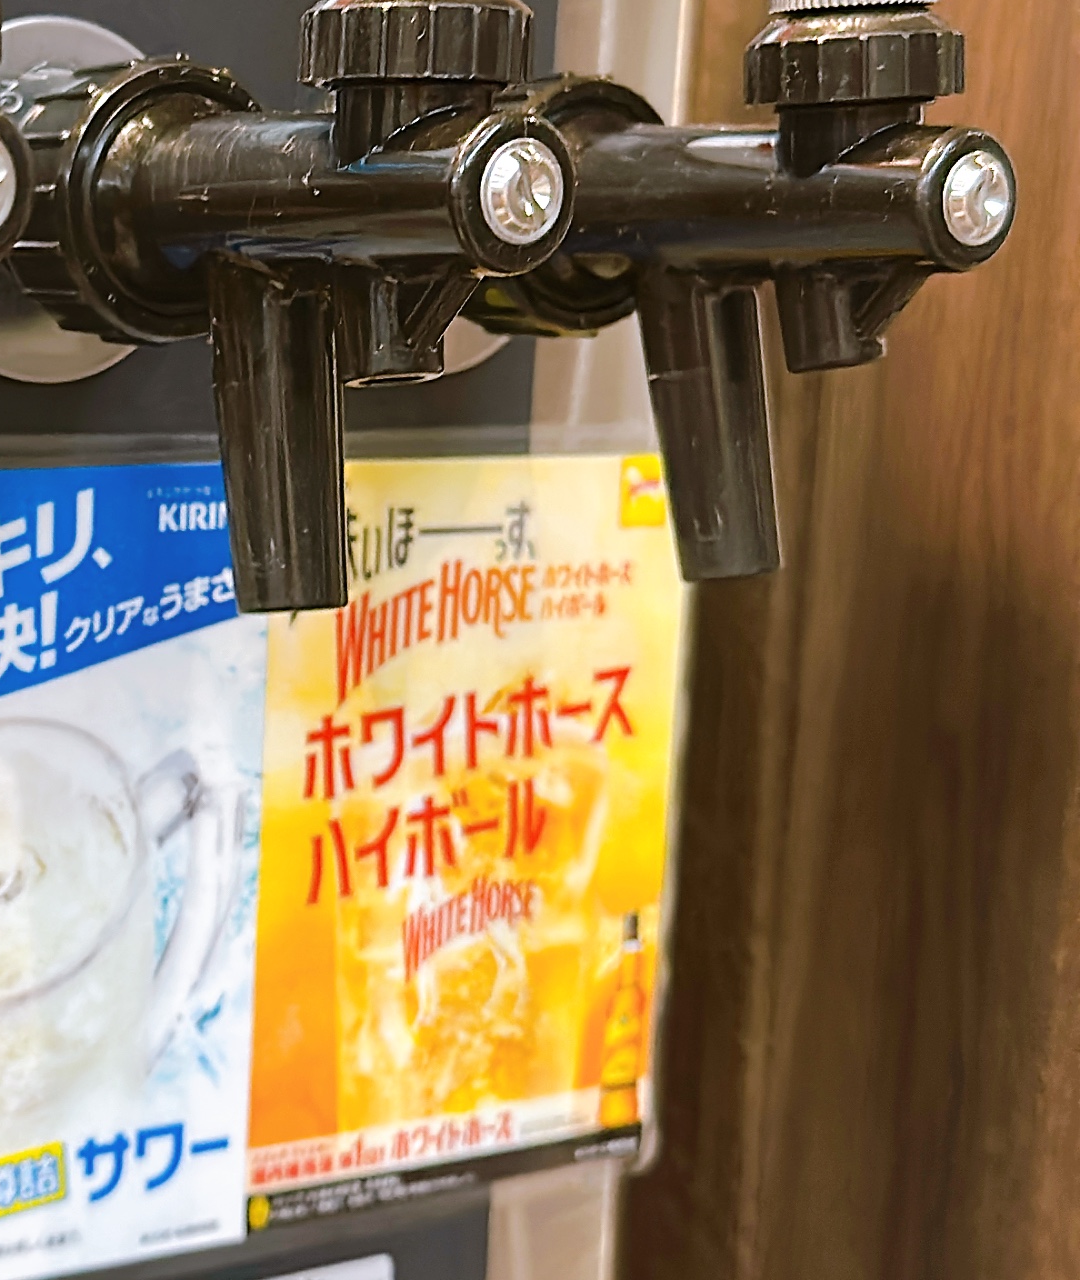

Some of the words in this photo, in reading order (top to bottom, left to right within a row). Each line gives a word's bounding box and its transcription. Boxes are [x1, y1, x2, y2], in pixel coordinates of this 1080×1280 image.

[336, 577, 436, 706] WHITE
[436, 558, 536, 640] HORSE
[303, 664, 634, 802] ホワイトホース
[307, 777, 547, 906] ハイボール
[77, 1122, 230, 1202] サワー
